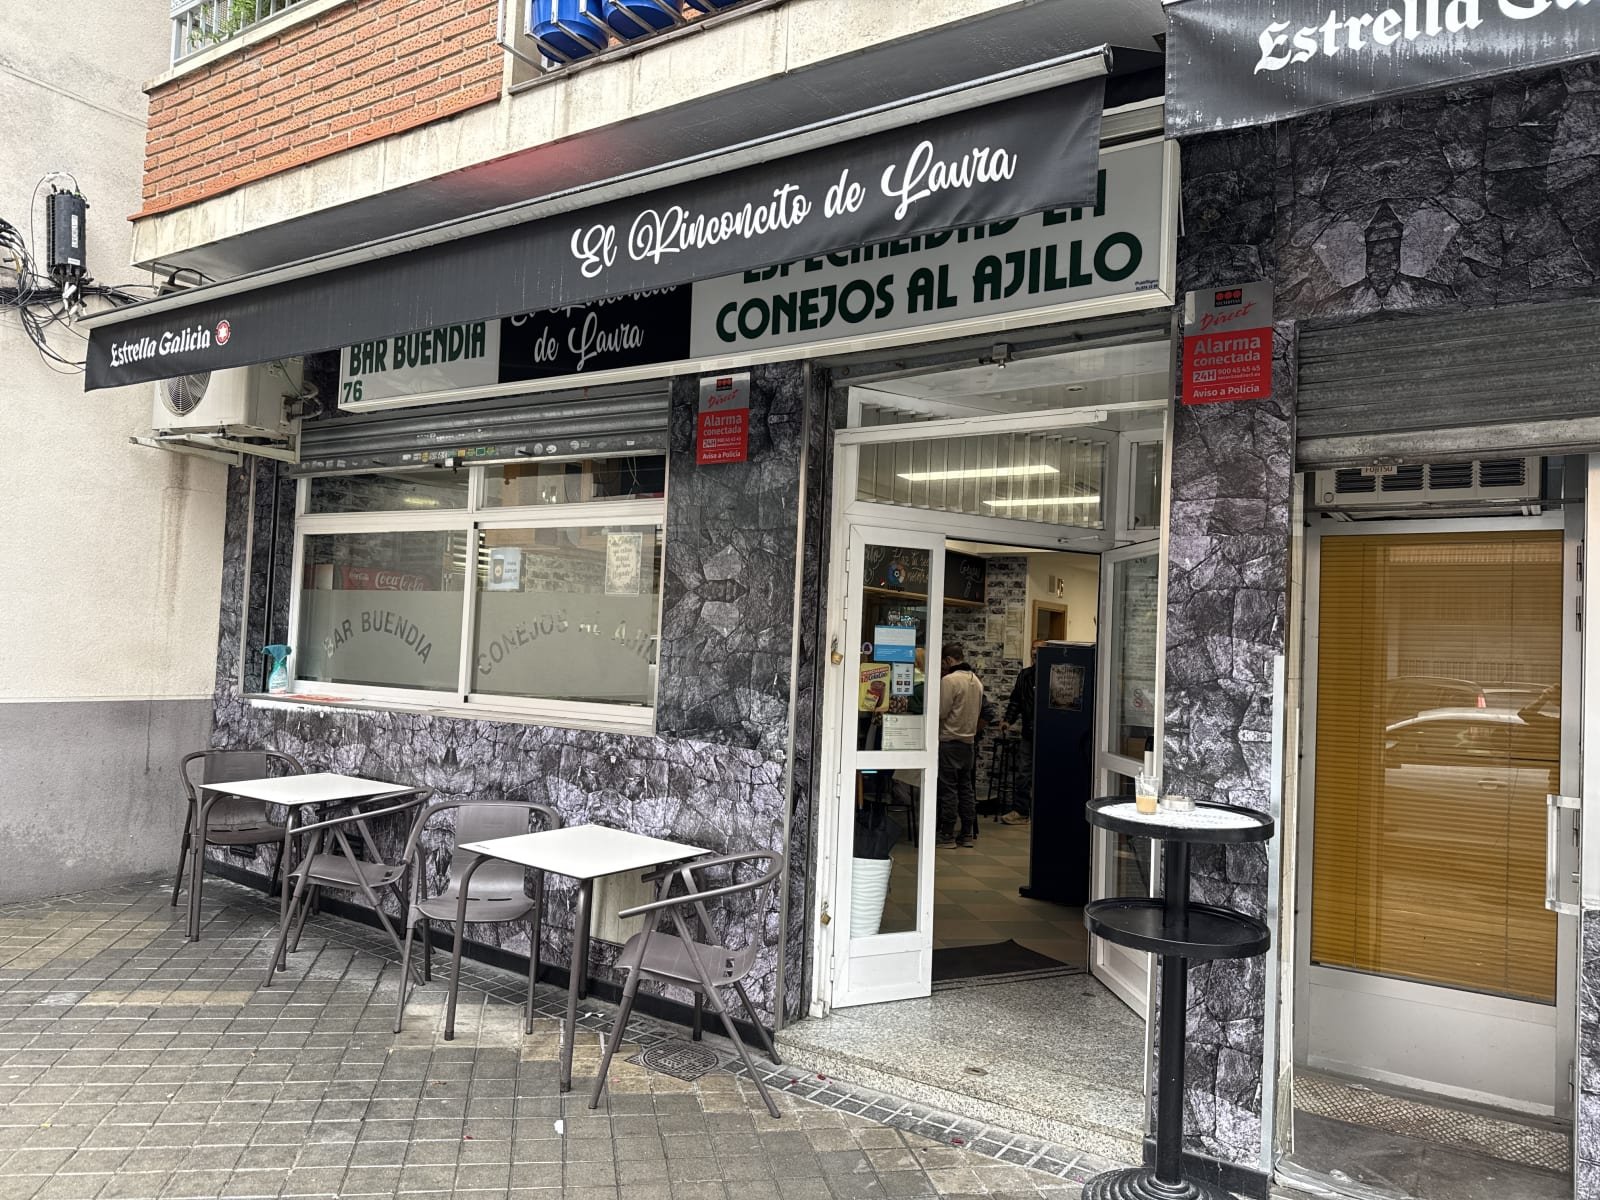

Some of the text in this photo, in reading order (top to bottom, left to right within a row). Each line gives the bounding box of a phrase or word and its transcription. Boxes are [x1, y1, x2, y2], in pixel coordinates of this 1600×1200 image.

[1254, 0, 1484, 75] Estrella
[571, 223, 617, 278] El
[628, 183, 811, 265] Rinconcito
[823, 168, 866, 219] de
[881, 140, 1017, 220] Laura
[716, 274, 894, 343] CONEJOS
[907, 264, 957, 314] AL
[973, 231, 1143, 303] AJILLO
[1200, 301, 1256, 330] Direct
[110, 324, 211, 367] Estrella Galicia
[349, 320, 485, 377] BAR BUENDIA
[534, 311, 644, 372] de Laura
[1194, 336, 1261, 355] Alarma
[1193, 351, 1260, 367] conectada
[1194, 369, 1216, 382] 24H
[343, 381, 362, 403] 76
[1193, 387, 1217, 398] Aviso
[1220, 388, 1226, 396] a
[703, 425, 741, 436] conectada
[704, 414, 742, 427] Alarma
[703, 452, 717, 460] Aviso
[323, 609, 433, 664] BAR BUENDIA
[478, 607, 568, 675] CONEJOS
